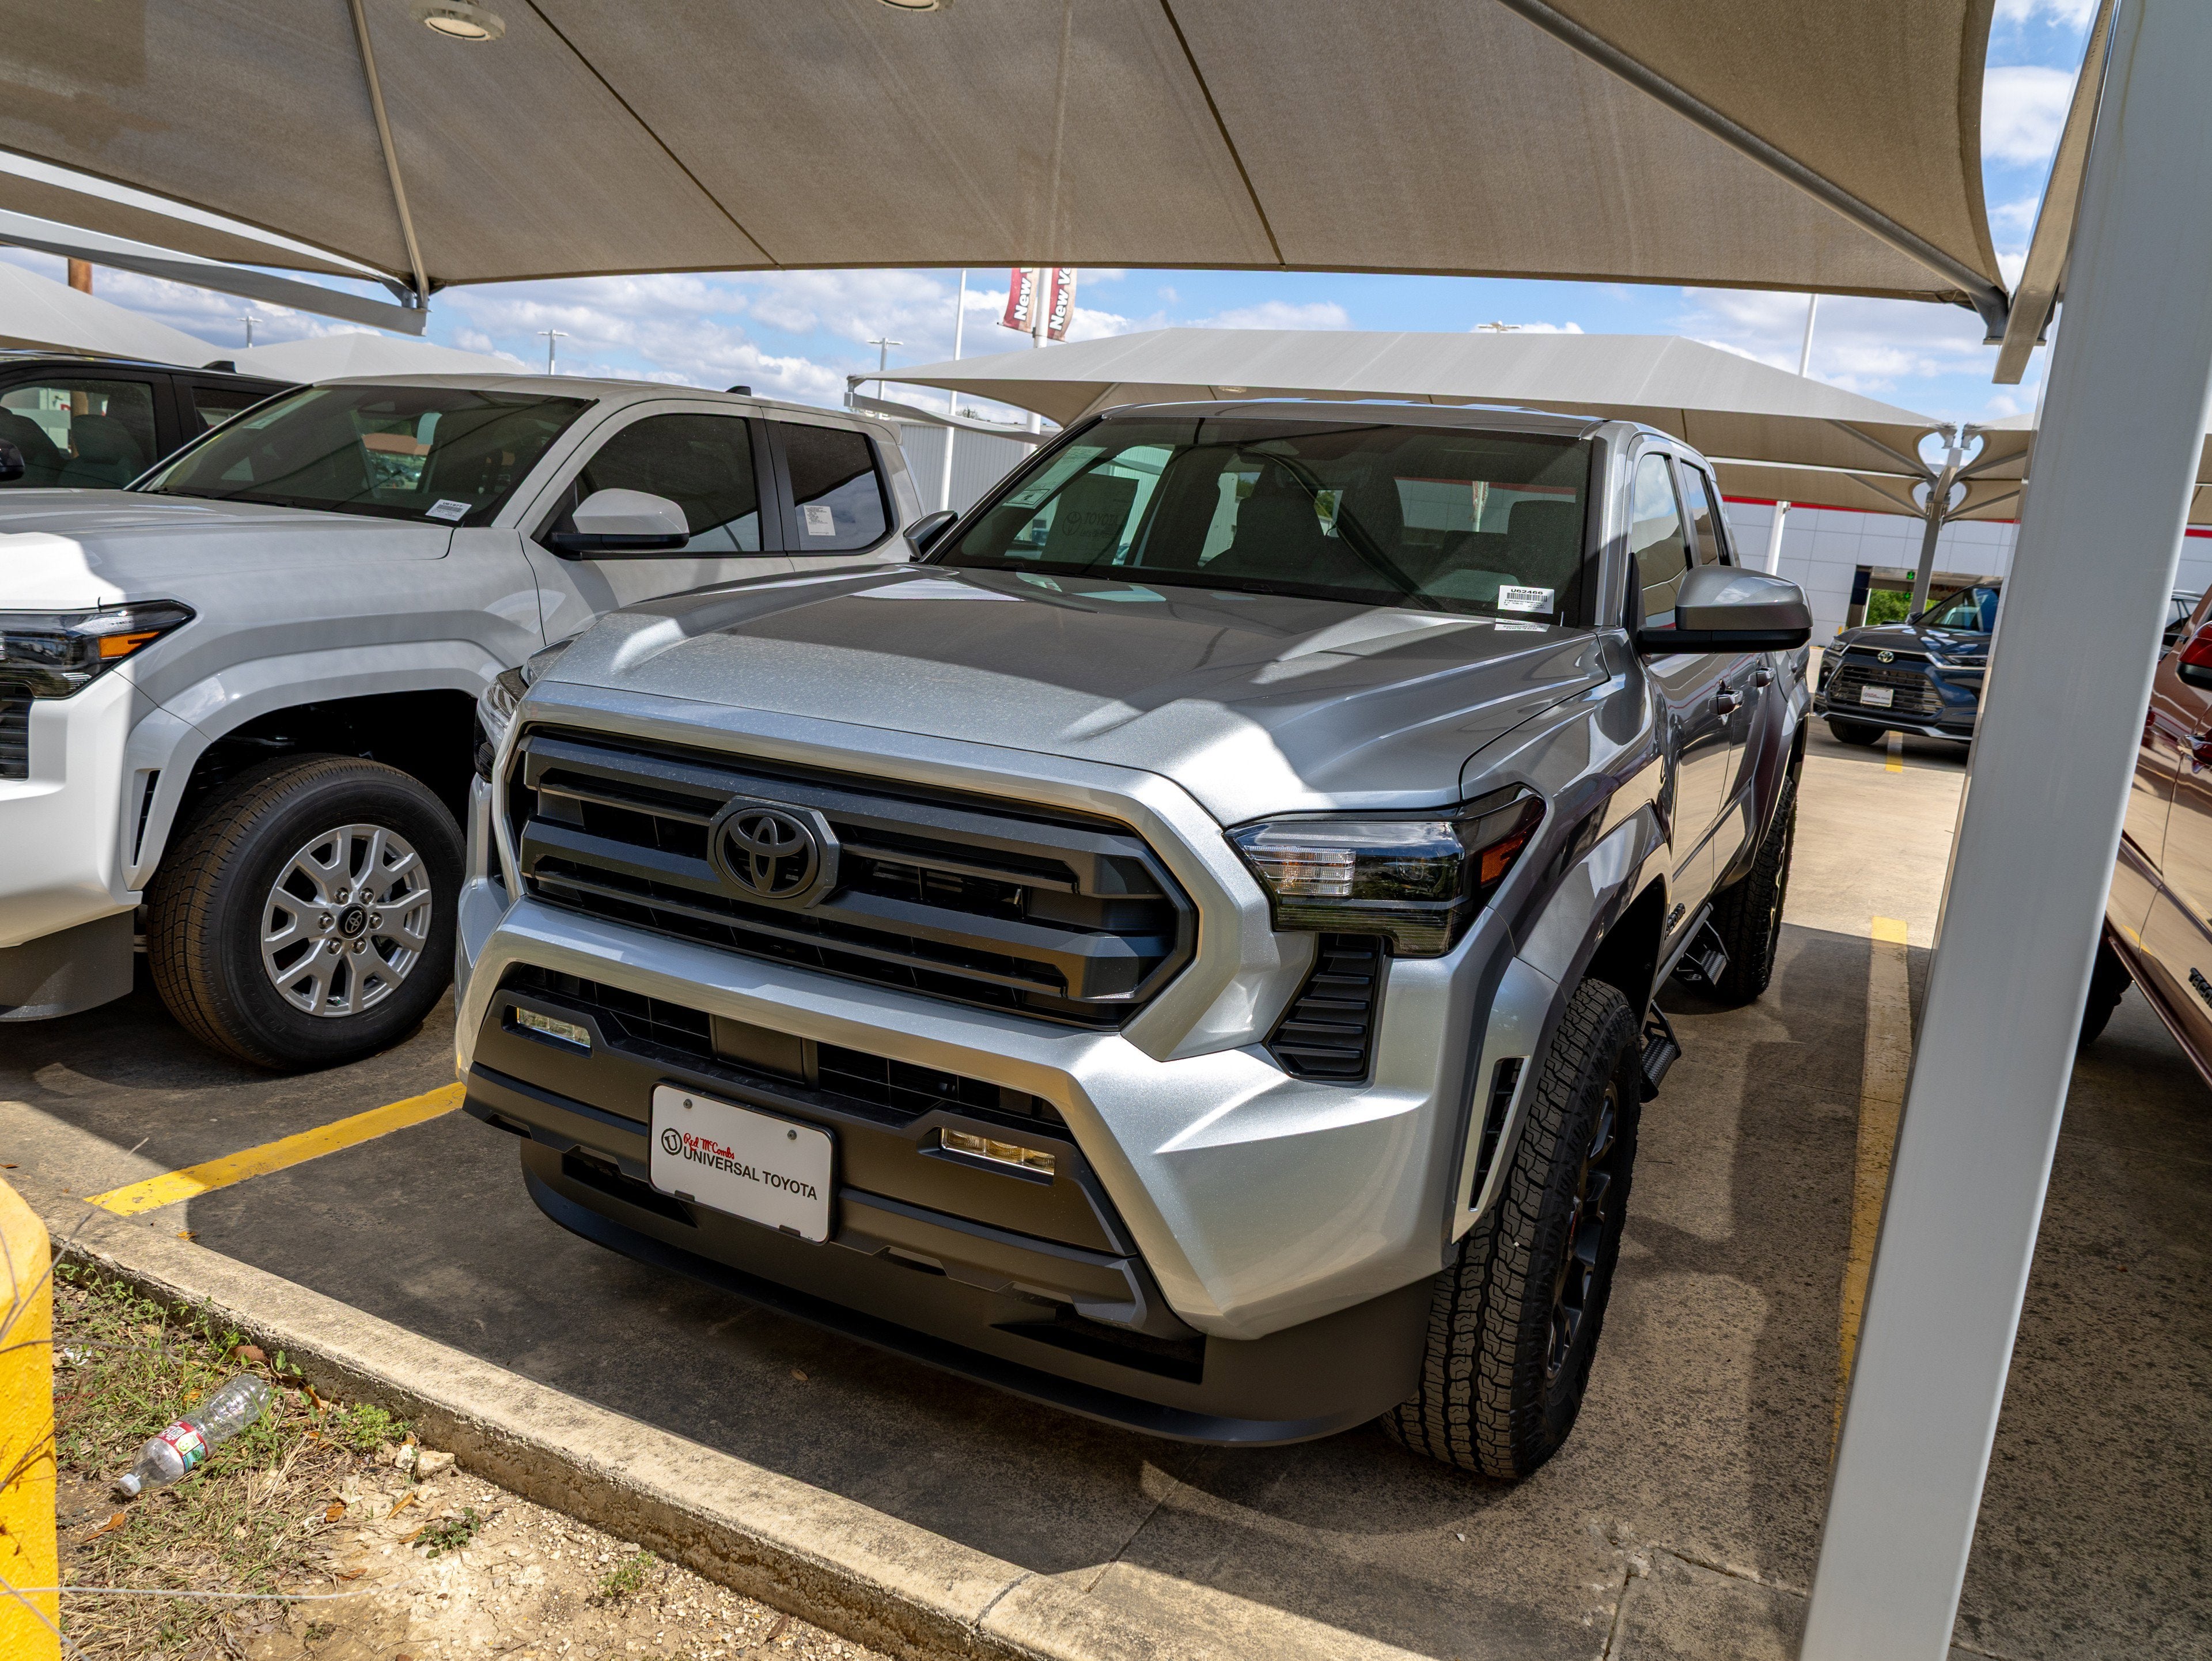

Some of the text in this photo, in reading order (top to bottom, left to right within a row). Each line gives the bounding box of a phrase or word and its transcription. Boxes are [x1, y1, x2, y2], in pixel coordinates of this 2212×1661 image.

[1014, 277, 1032, 321] New
[1049, 289, 1069, 331] New
[684, 1133, 735, 1160] Red McCombs
[684, 1146, 817, 1200] UNIVERSAL TOYOTA
